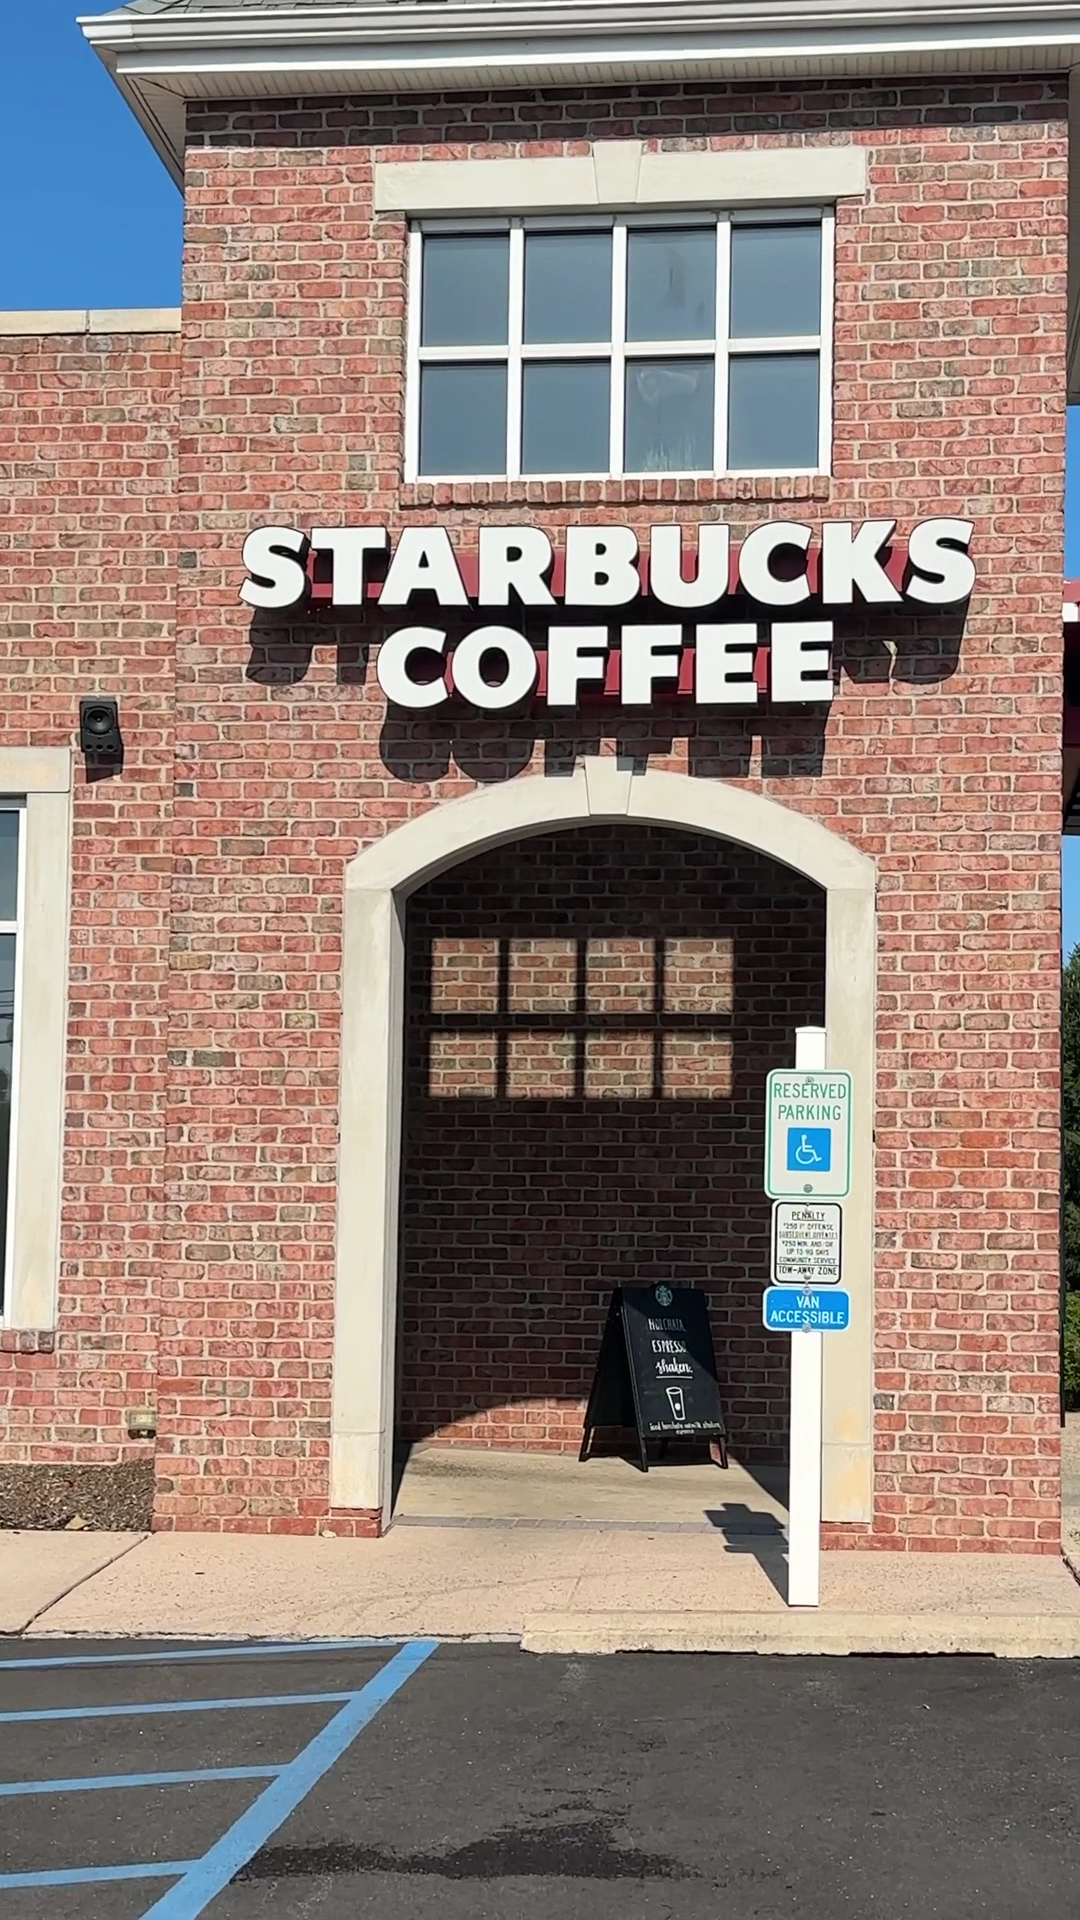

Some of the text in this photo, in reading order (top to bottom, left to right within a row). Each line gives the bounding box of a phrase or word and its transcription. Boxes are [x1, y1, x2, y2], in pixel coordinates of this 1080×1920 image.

[239, 518, 975, 609] STARBUCKS
[376, 620, 834, 709] COFFEE
[773, 1083, 847, 1099] RESERVED
[778, 1104, 842, 1121] PARKING
[791, 1211, 826, 1221] PENALTY
[778, 1265, 838, 1276] TOW-AWAY ZONE
[796, 1296, 820, 1309] VAN
[769, 1309, 846, 1325] ACCESSIBLE
